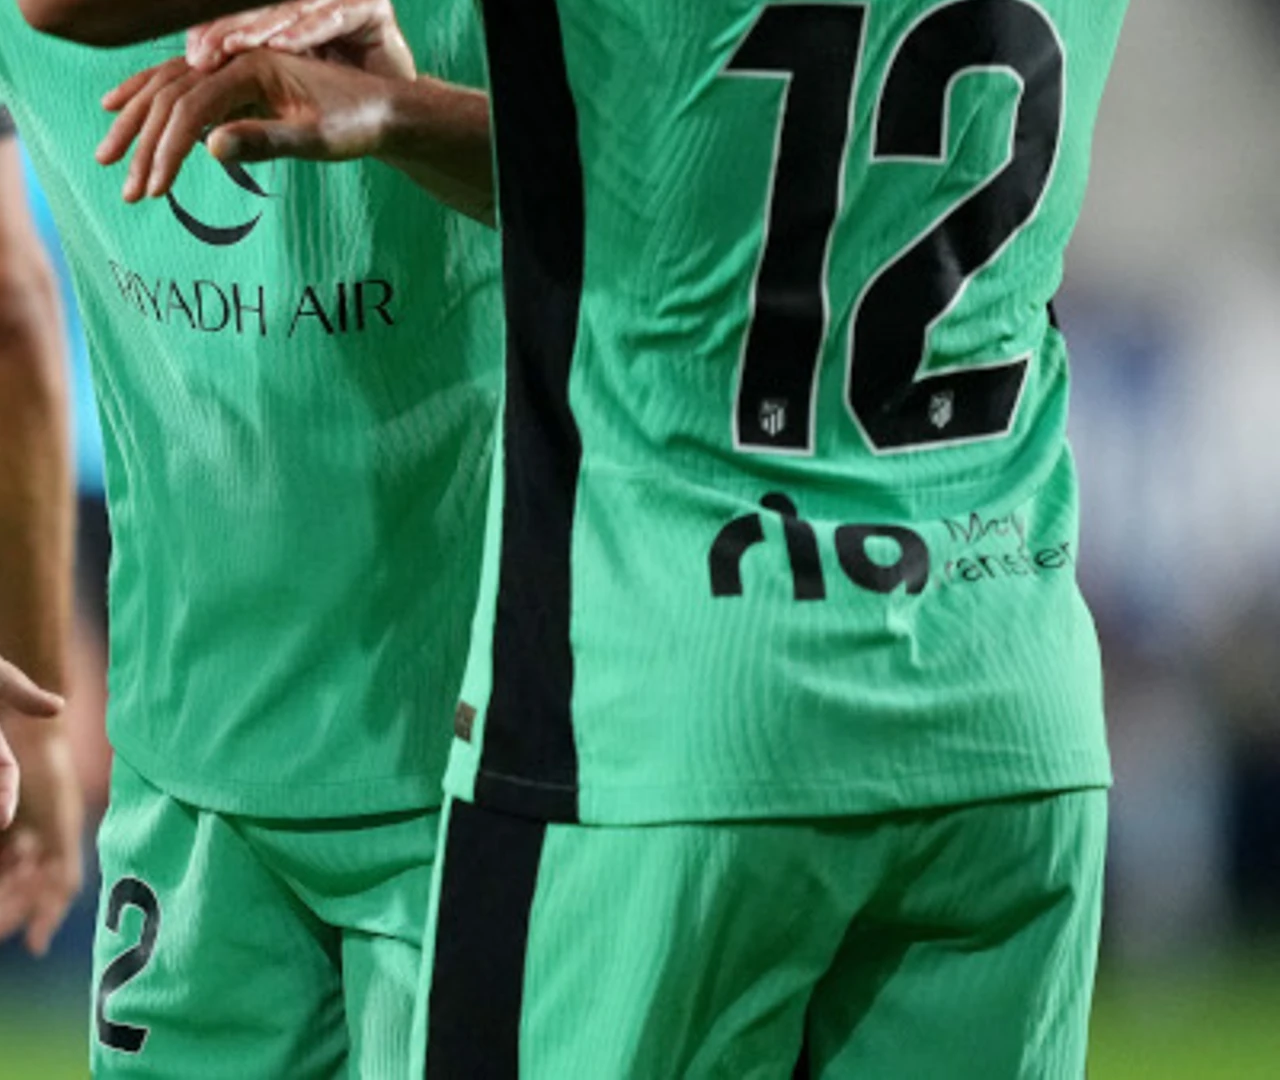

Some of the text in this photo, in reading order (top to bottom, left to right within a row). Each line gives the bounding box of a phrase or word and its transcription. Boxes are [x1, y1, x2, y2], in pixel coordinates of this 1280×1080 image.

[287, 279, 396, 338] AIR
[707, 491, 930, 601] ria
[96, 876, 162, 1053] 2
